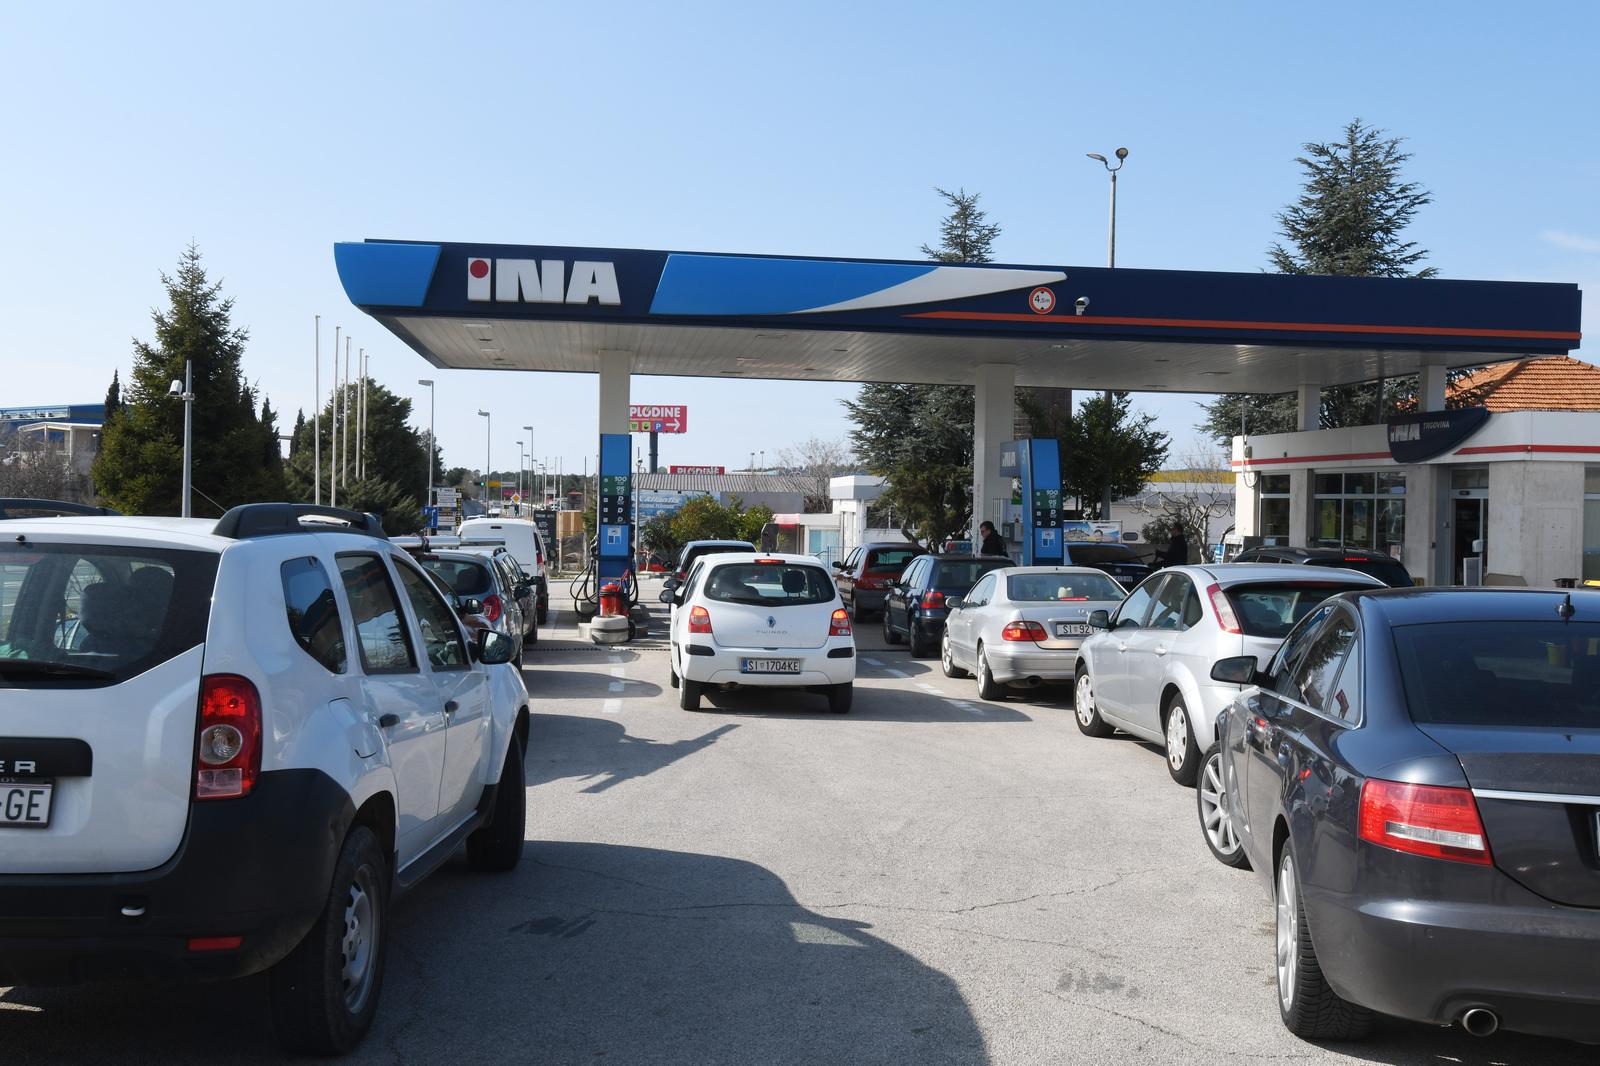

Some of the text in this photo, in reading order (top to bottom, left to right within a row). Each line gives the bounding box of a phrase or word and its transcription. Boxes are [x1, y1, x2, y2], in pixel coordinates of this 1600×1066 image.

[467, 257, 621, 306] INA
[630, 407, 680, 417] PLODINE
[1390, 423, 1420, 442] INA
[748, 661, 799, 671] SI 1704-KE
